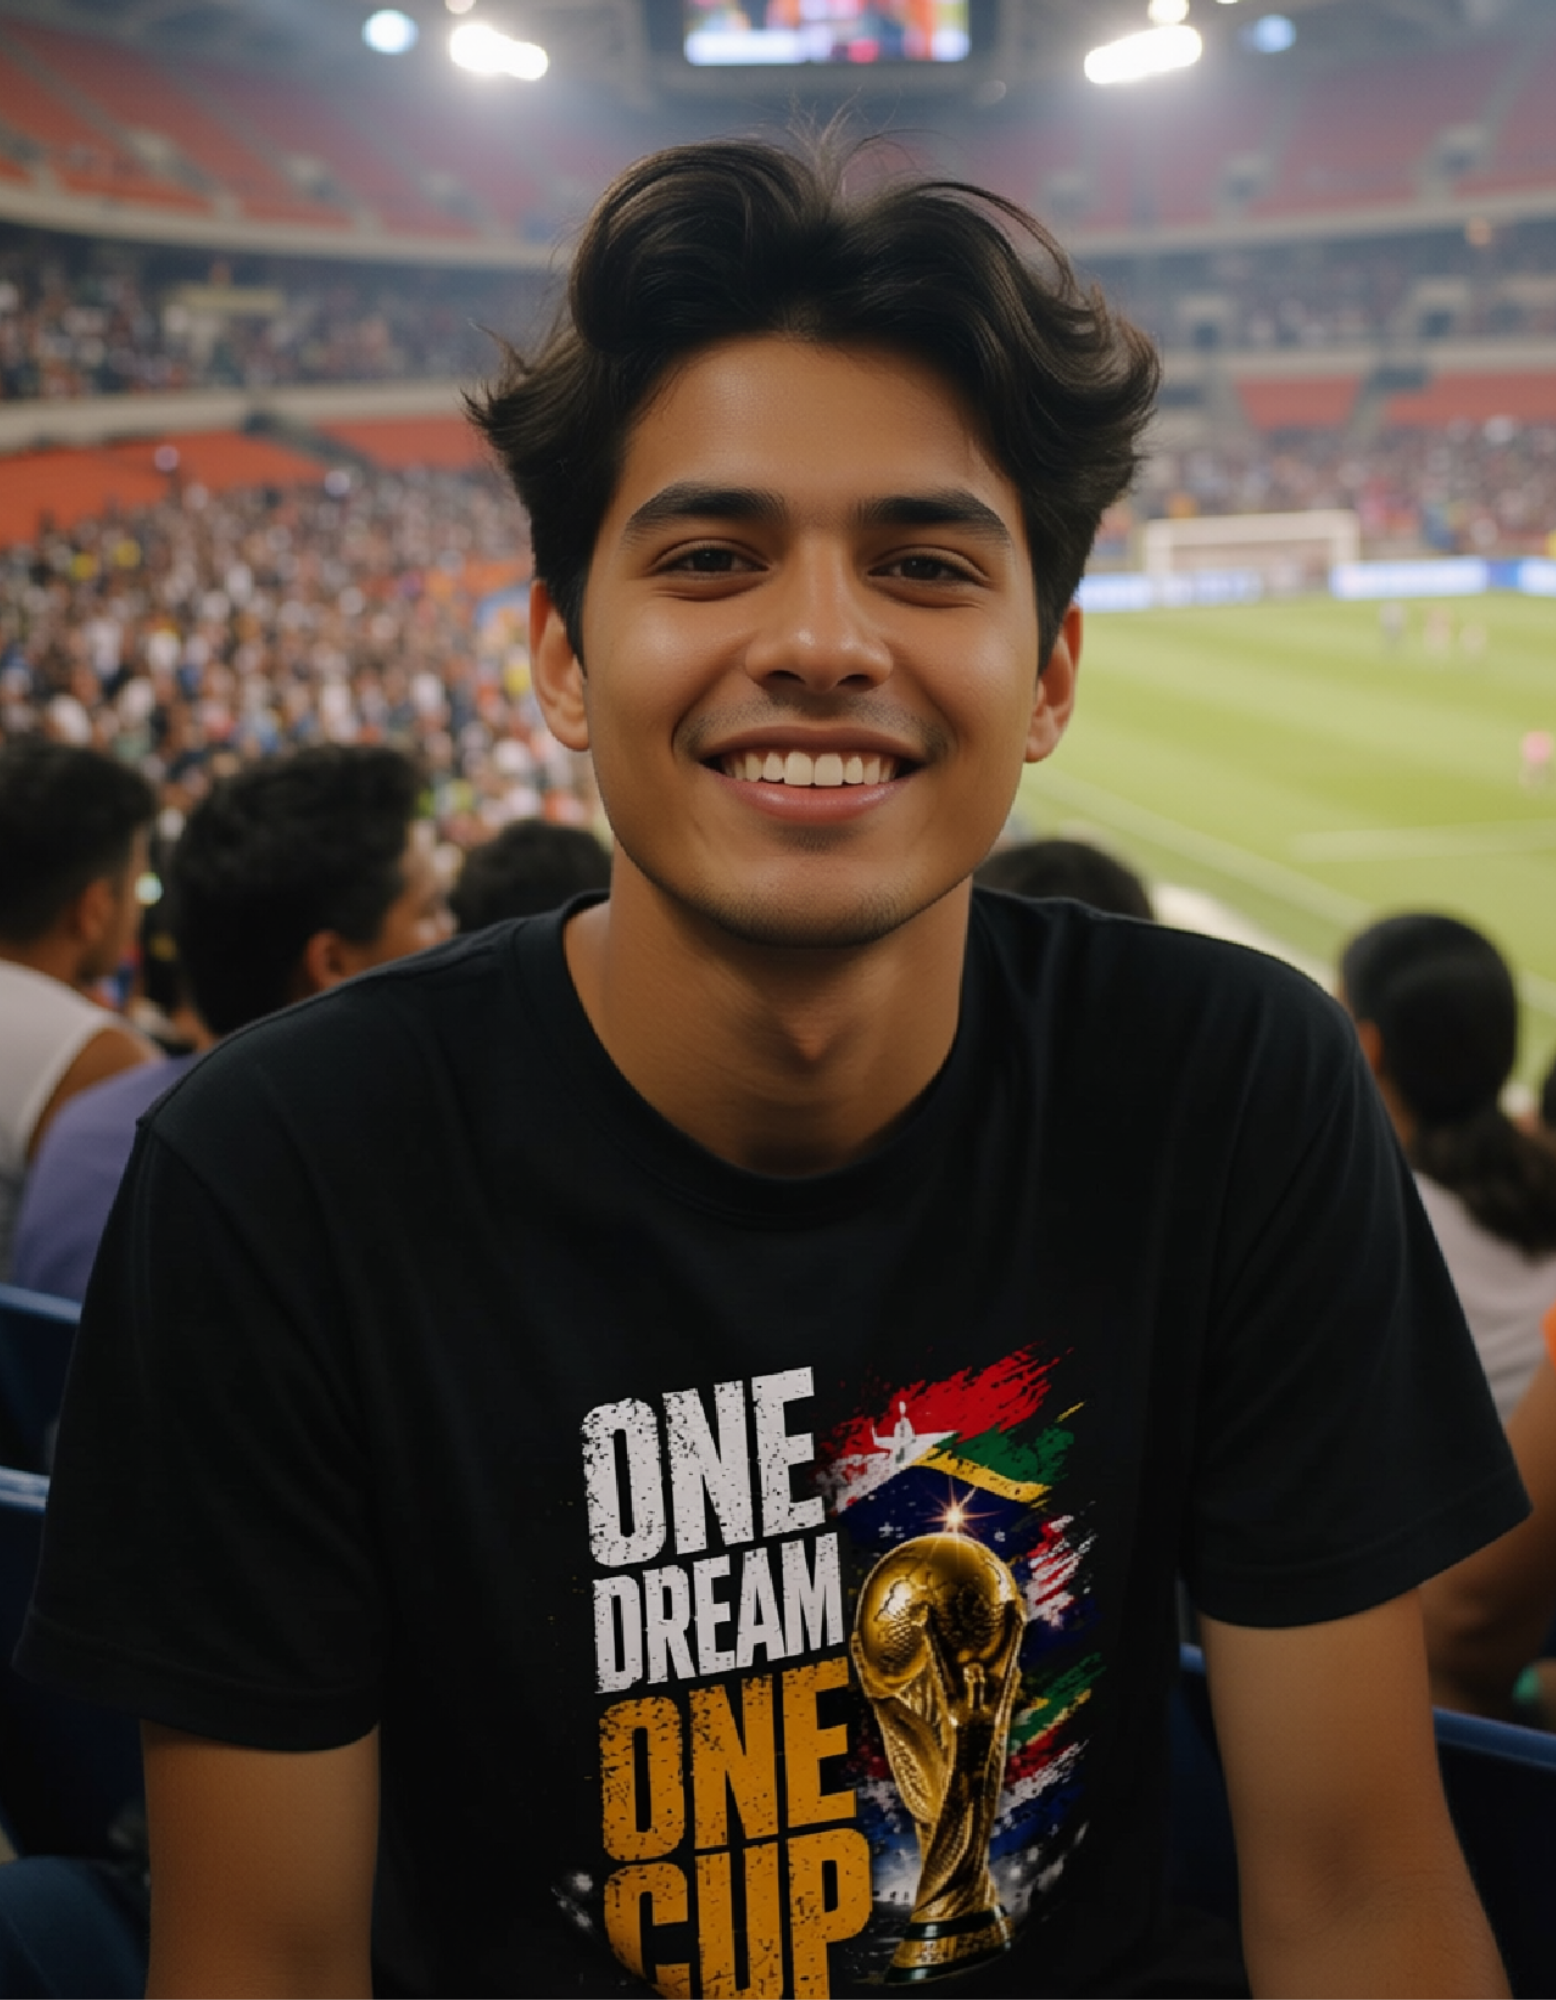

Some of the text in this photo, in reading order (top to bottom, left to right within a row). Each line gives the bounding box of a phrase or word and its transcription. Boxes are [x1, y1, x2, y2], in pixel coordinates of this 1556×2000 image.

[580, 1366, 826, 1567] ONE
[593, 1533, 844, 1694] DREAM
[599, 1657, 857, 1862] ONE
[604, 1827, 873, 2000] CUP
